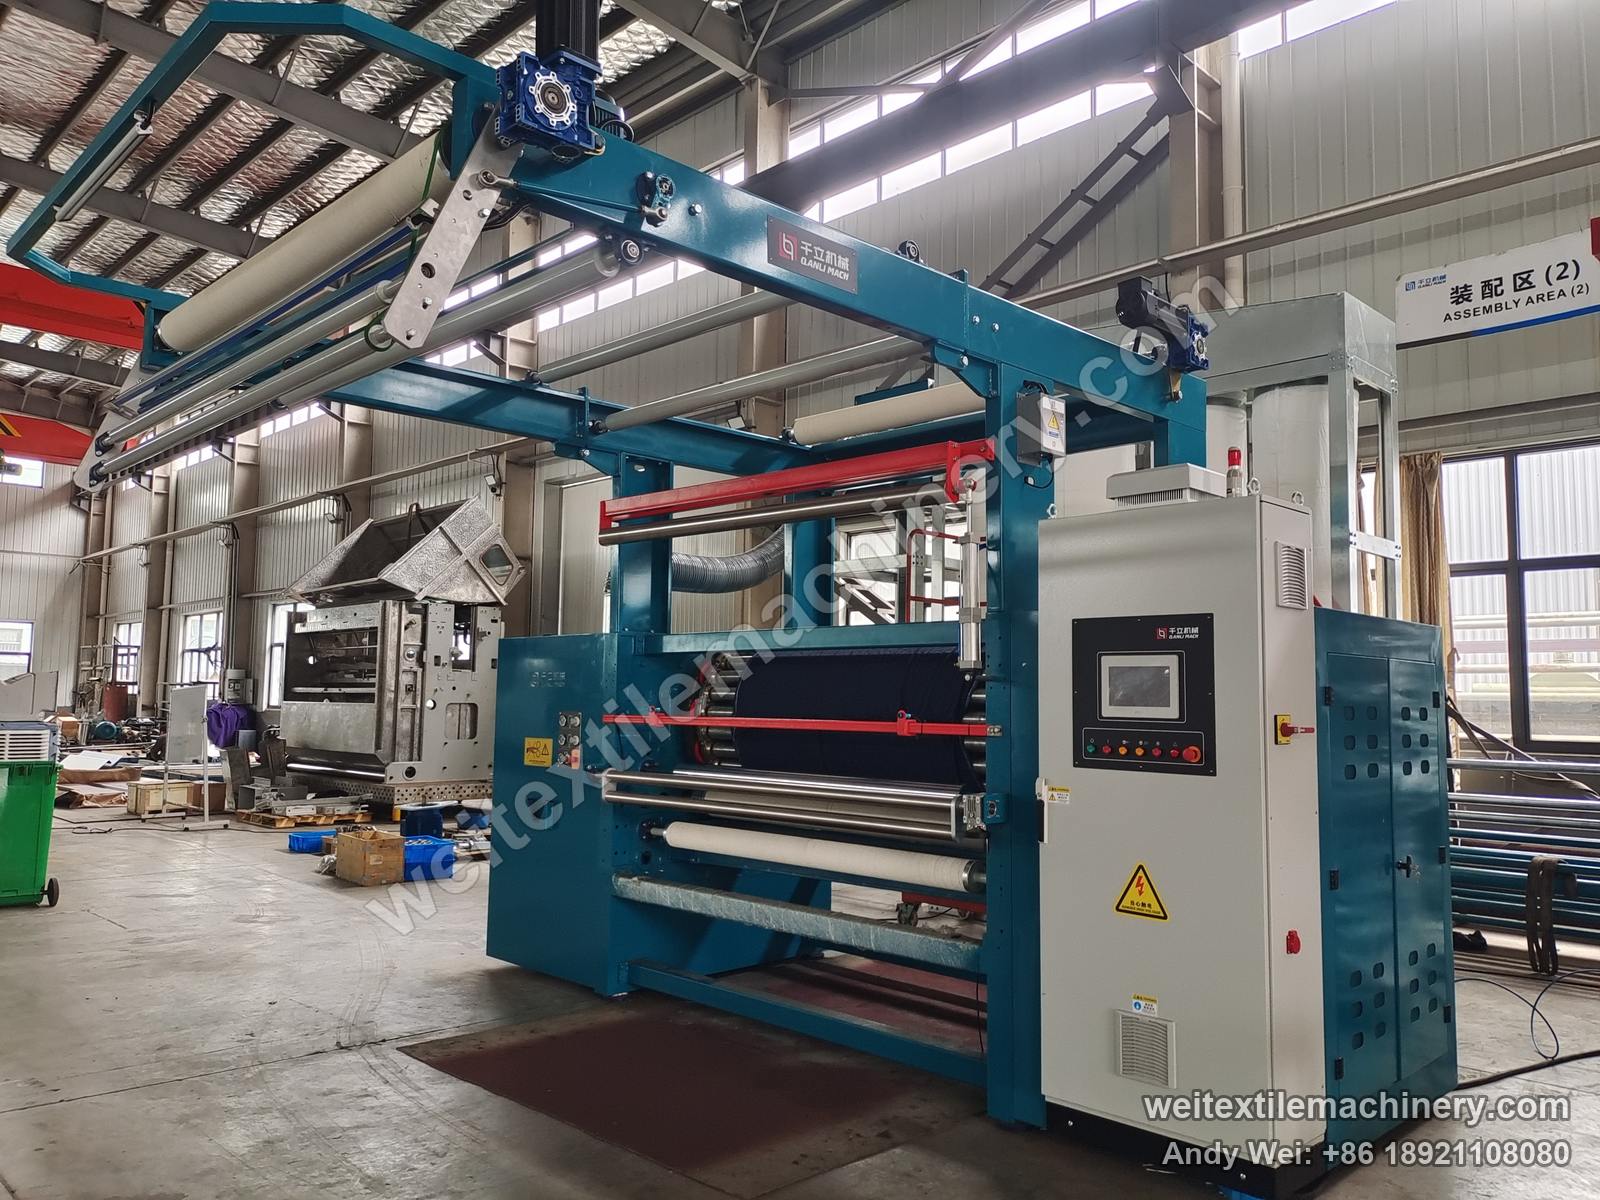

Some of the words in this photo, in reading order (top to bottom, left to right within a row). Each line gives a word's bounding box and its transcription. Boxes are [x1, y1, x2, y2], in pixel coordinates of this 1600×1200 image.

[800, 257, 826, 273] QANLI
[827, 267, 849, 280] MACH
[801, 241, 850, 271] 千立机械
[1443, 299, 1521, 323] ASSEMBLY
[1525, 288, 1567, 307] AREA
[1571, 283, 1590, 298] (2)
